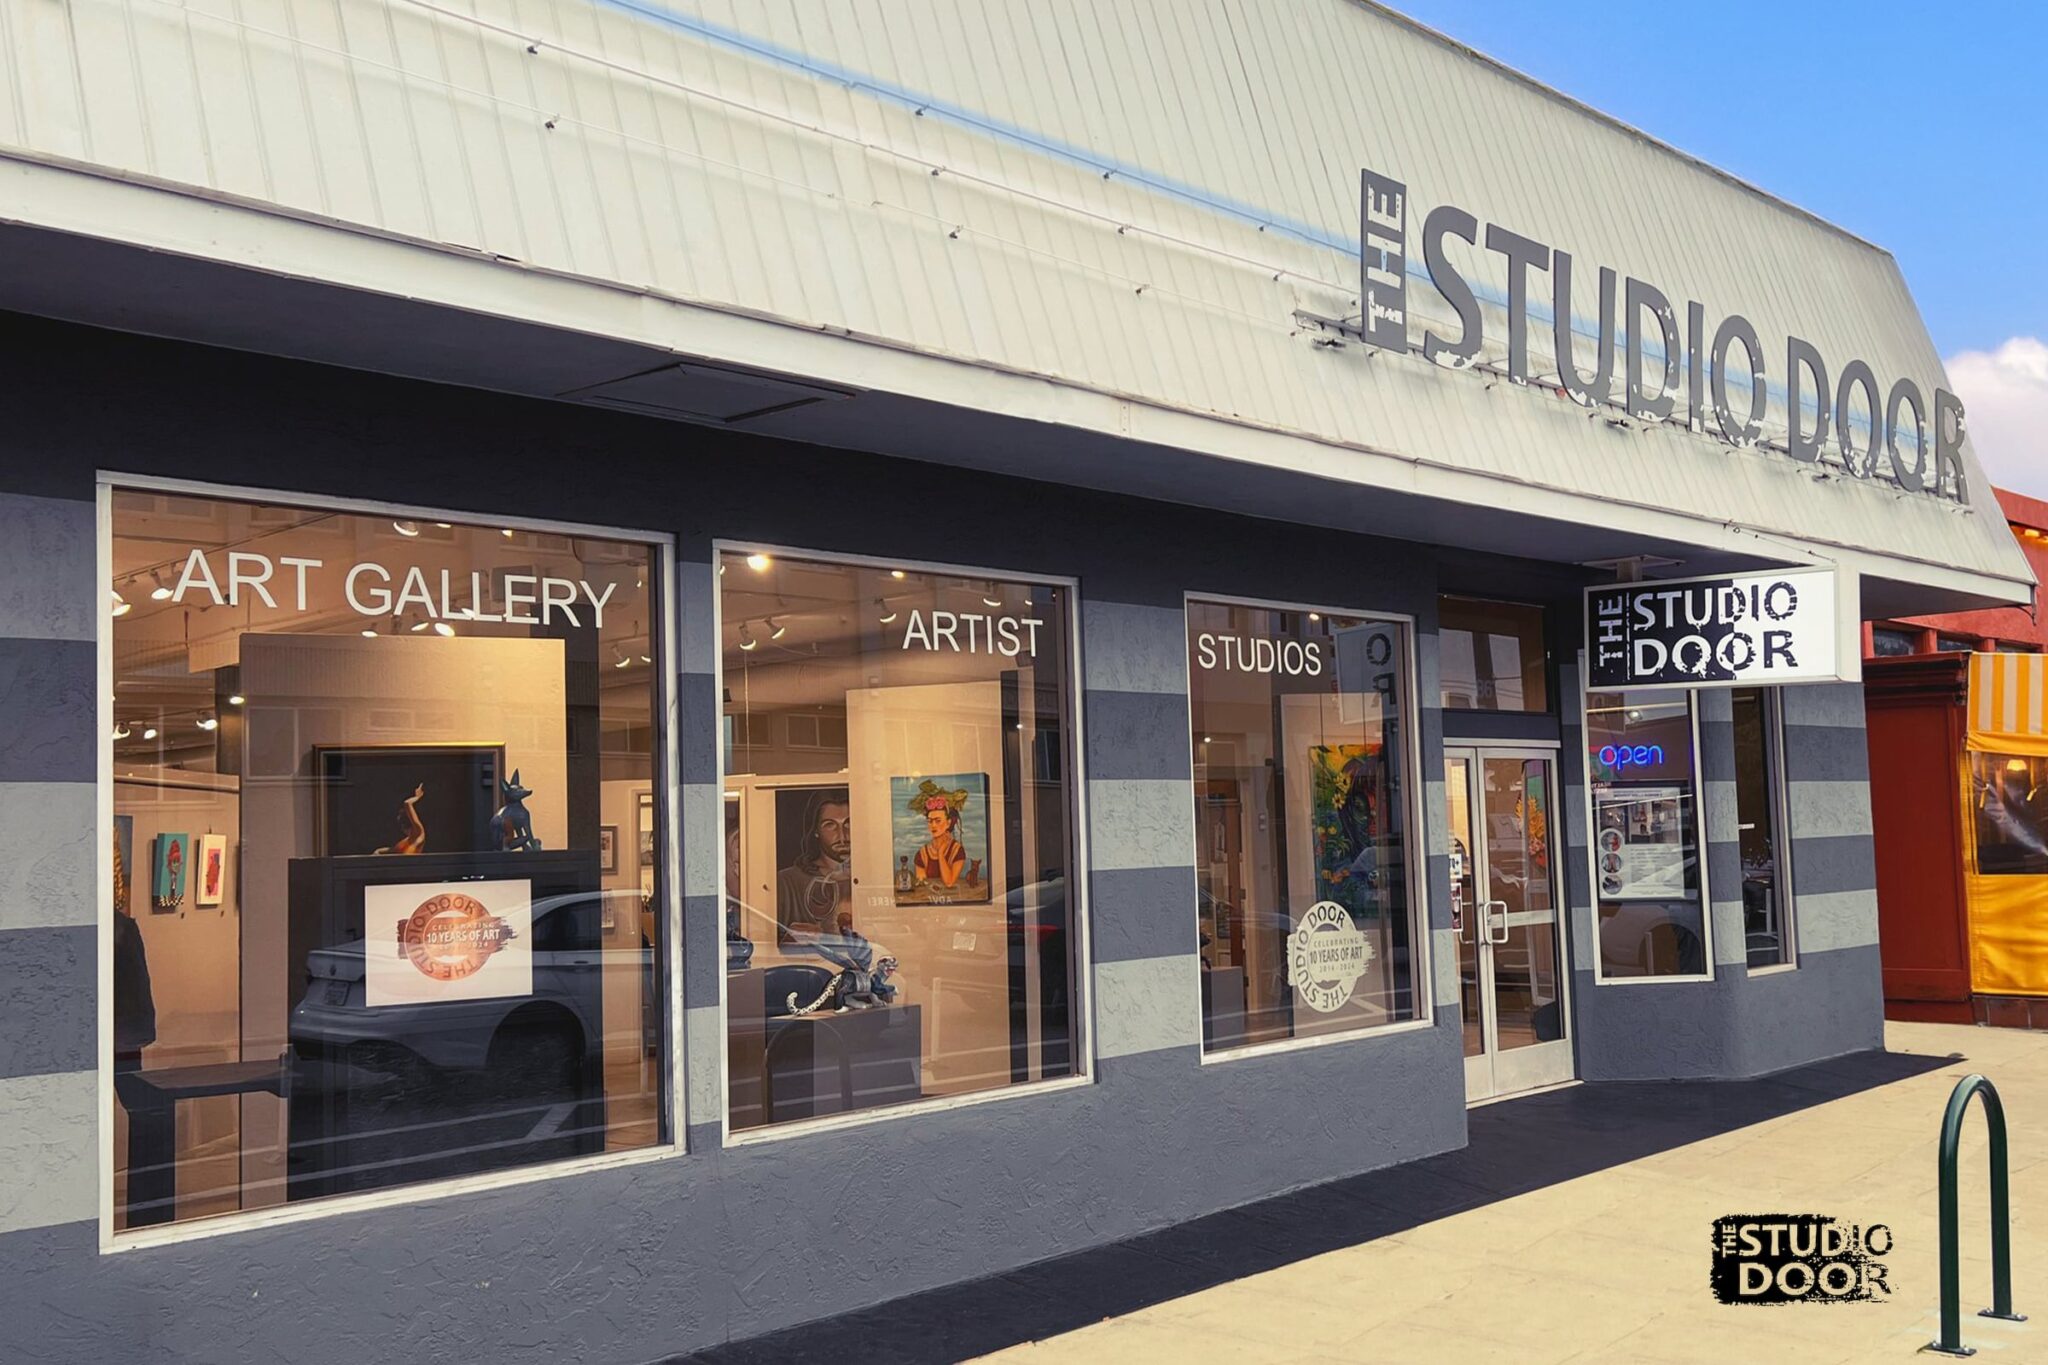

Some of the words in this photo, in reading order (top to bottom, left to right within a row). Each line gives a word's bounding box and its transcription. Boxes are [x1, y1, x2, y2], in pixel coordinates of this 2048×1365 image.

[1367, 183, 1403, 333] THE
[1422, 204, 1766, 449] STUDIO
[1787, 336, 1971, 505] DOOR
[171, 549, 323, 612] ART
[344, 562, 618, 629] GALLERY
[1633, 580, 1799, 631] STUDIO
[902, 610, 1044, 658] ARTIST
[1197, 632, 1322, 676] STUDIOS
[1598, 594, 1624, 667] THE
[1633, 630, 1800, 677] DOOR
[1598, 744, 1664, 771] open
[425, 896, 477, 915] DOOR
[1307, 905, 1346, 929] DOOR
[407, 915, 438, 974] STUDIO
[426, 932, 437, 944] 10
[438, 930, 467, 943] YEARS
[469, 929, 481, 941] OF
[482, 928, 501, 940] ART
[1309, 949, 1317, 965] 10
[1318, 947, 1339, 963] YEARS
[1340, 946, 1349, 961] OF
[1350, 945, 1363, 960] ART
[442, 959, 478, 978] THE
[1296, 929, 1319, 1004] STUDIO
[1322, 985, 1348, 1009] THE
